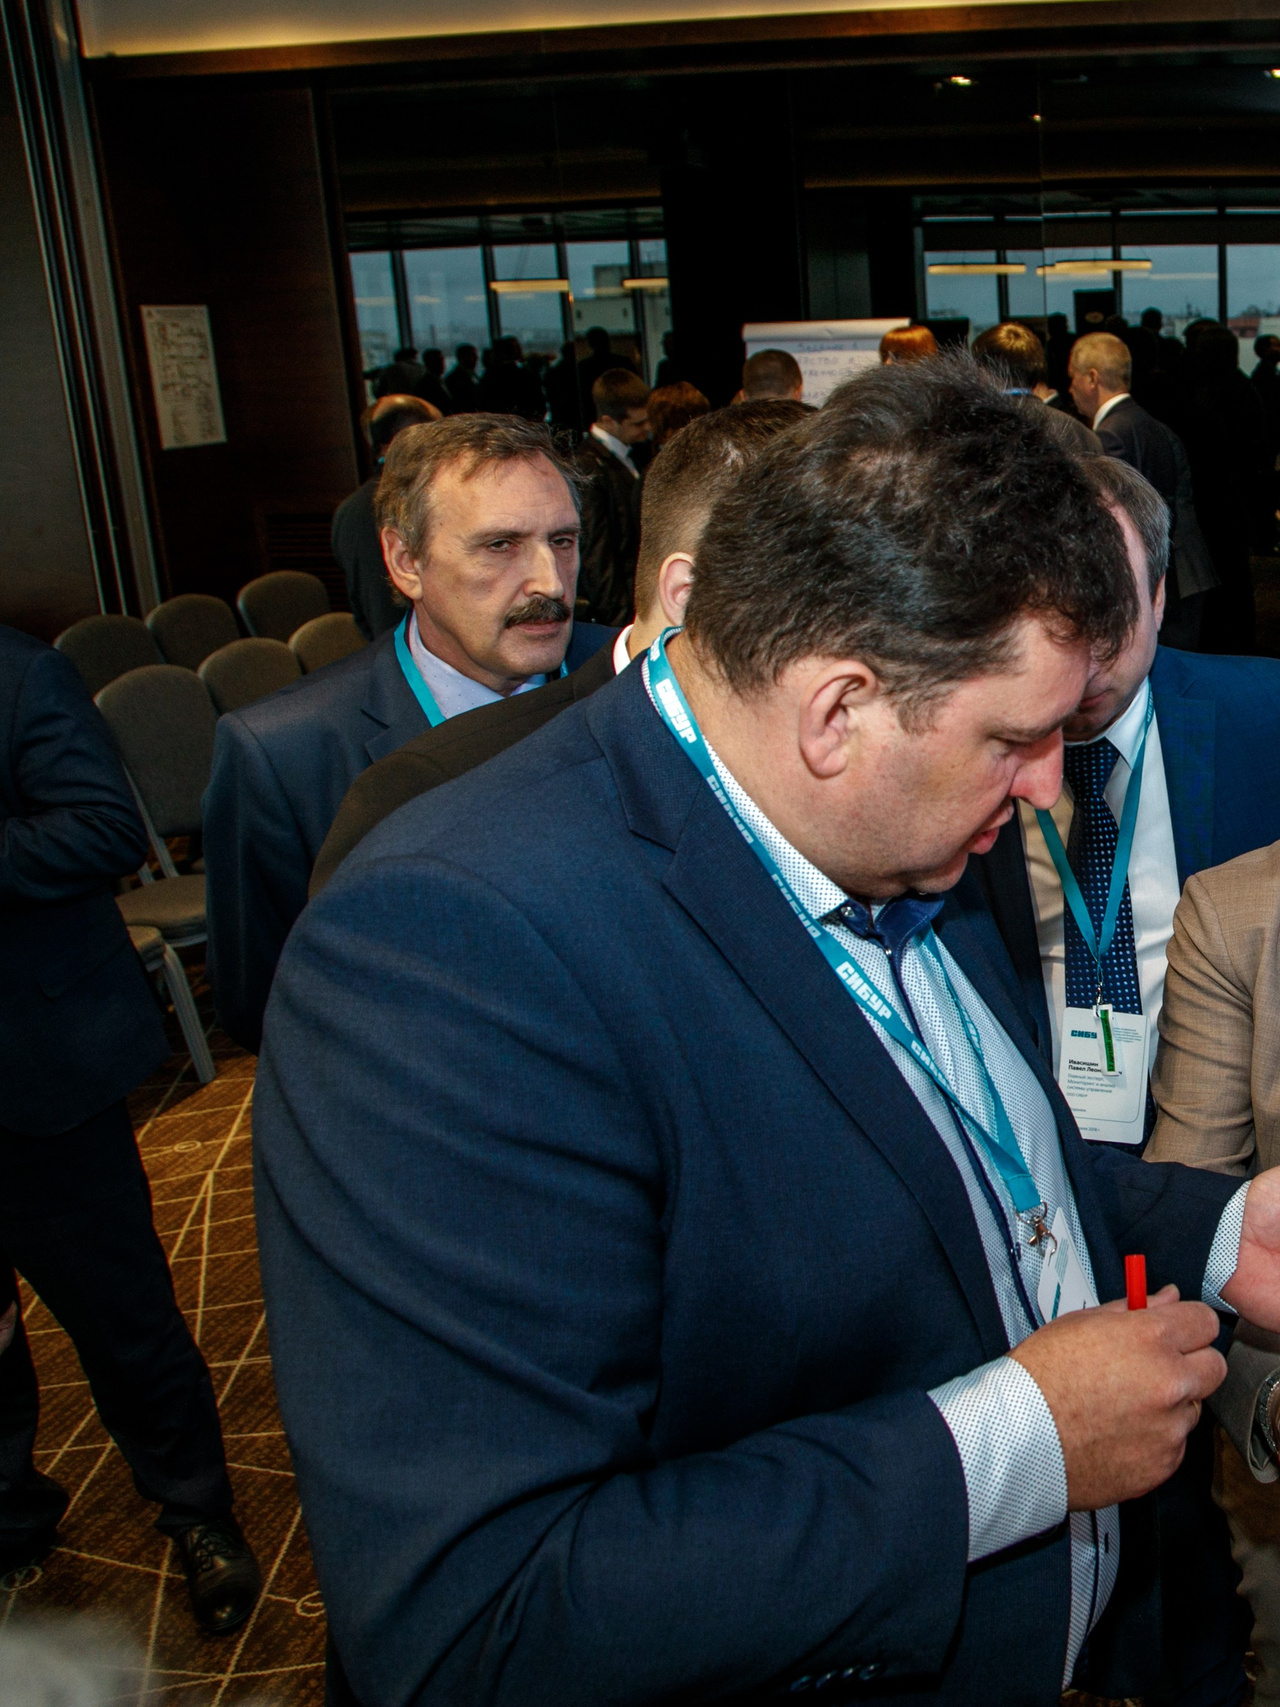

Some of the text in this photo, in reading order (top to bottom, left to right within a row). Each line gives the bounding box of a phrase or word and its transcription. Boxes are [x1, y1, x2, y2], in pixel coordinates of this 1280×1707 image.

[655, 678, 697, 744] СИБУР
[835, 961, 892, 1019] СИБУР
[1068, 1059, 1099, 1067] Ивасишин
